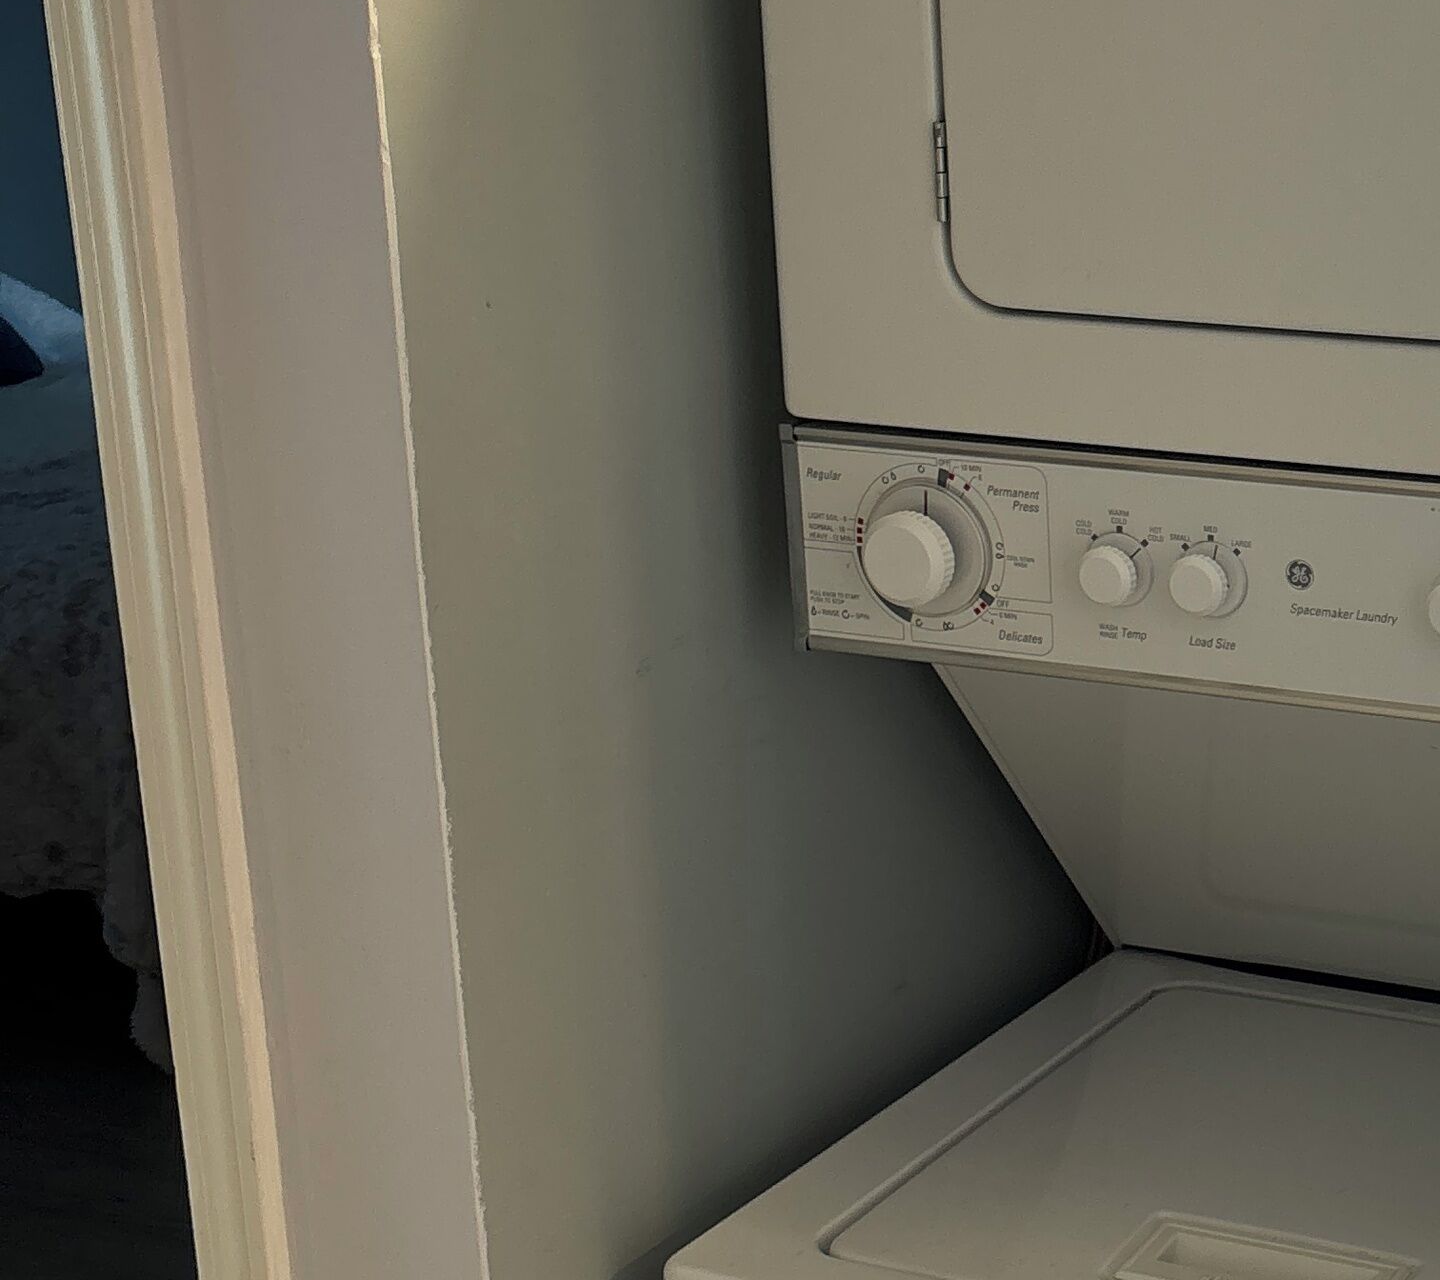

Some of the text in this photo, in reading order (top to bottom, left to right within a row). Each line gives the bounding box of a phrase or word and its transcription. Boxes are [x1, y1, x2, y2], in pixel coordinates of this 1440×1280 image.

[806, 466, 842, 481] Regular
[986, 484, 1040, 500] Permanent
[1012, 500, 1040, 513] Press
[1075, 519, 1093, 528] COLD
[1110, 517, 1128, 526] COLD
[1148, 526, 1162, 534] HOT
[1147, 534, 1165, 543] COLD
[1169, 533, 1192, 543] SMALL
[1231, 539, 1253, 549] LARGE
[1290, 602, 1399, 626] Spacemaker Laundry
[998, 629, 1044, 645] Delicates
[1121, 627, 1148, 642] Temp
[1189, 634, 1237, 651] Load Size
